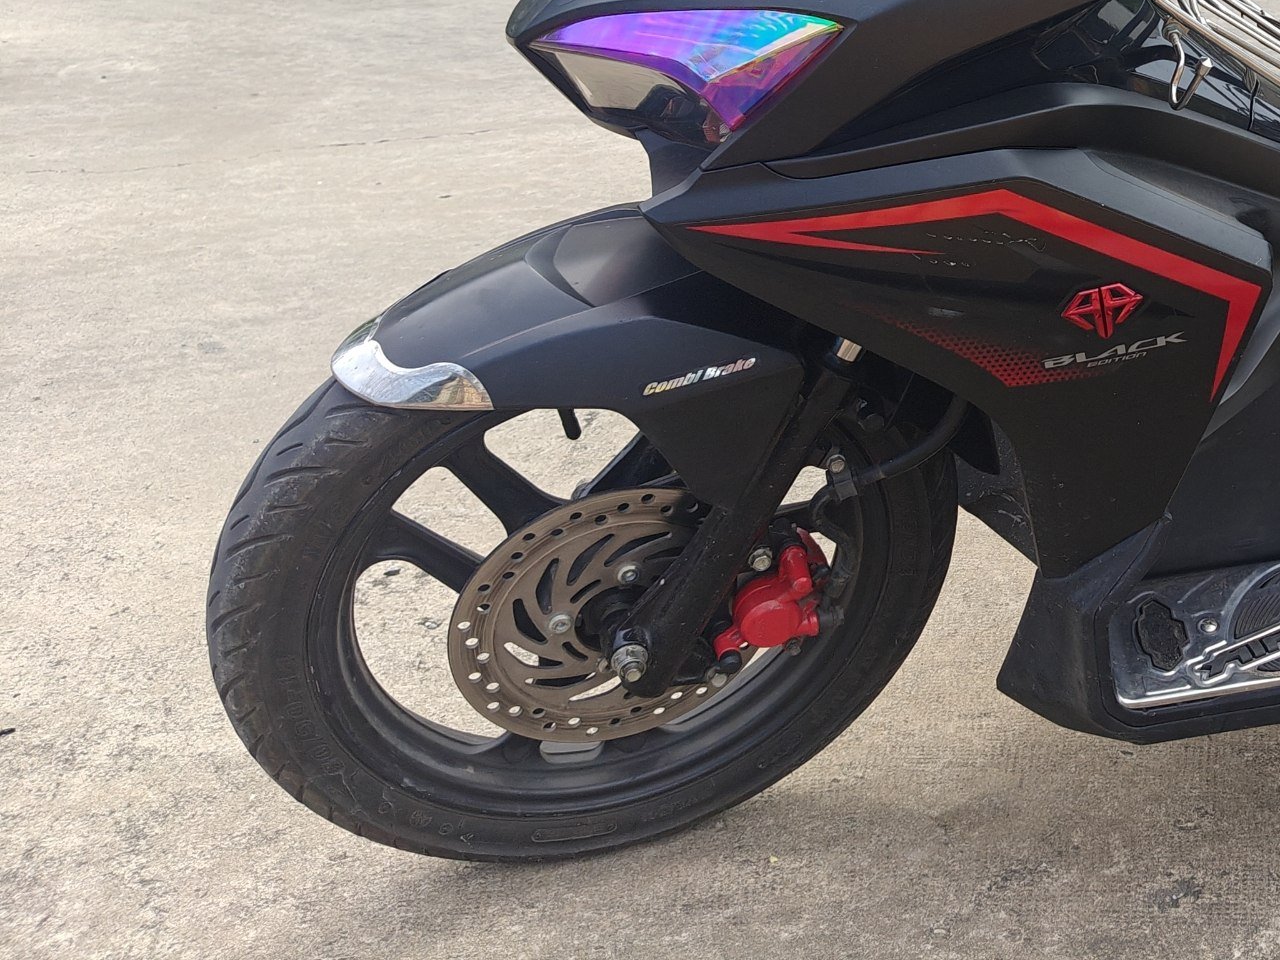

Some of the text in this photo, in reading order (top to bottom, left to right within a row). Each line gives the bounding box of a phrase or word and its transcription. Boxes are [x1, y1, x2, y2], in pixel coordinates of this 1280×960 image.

[1042, 331, 1188, 369] BLACK
[642, 357, 757, 396] Combi Brake
